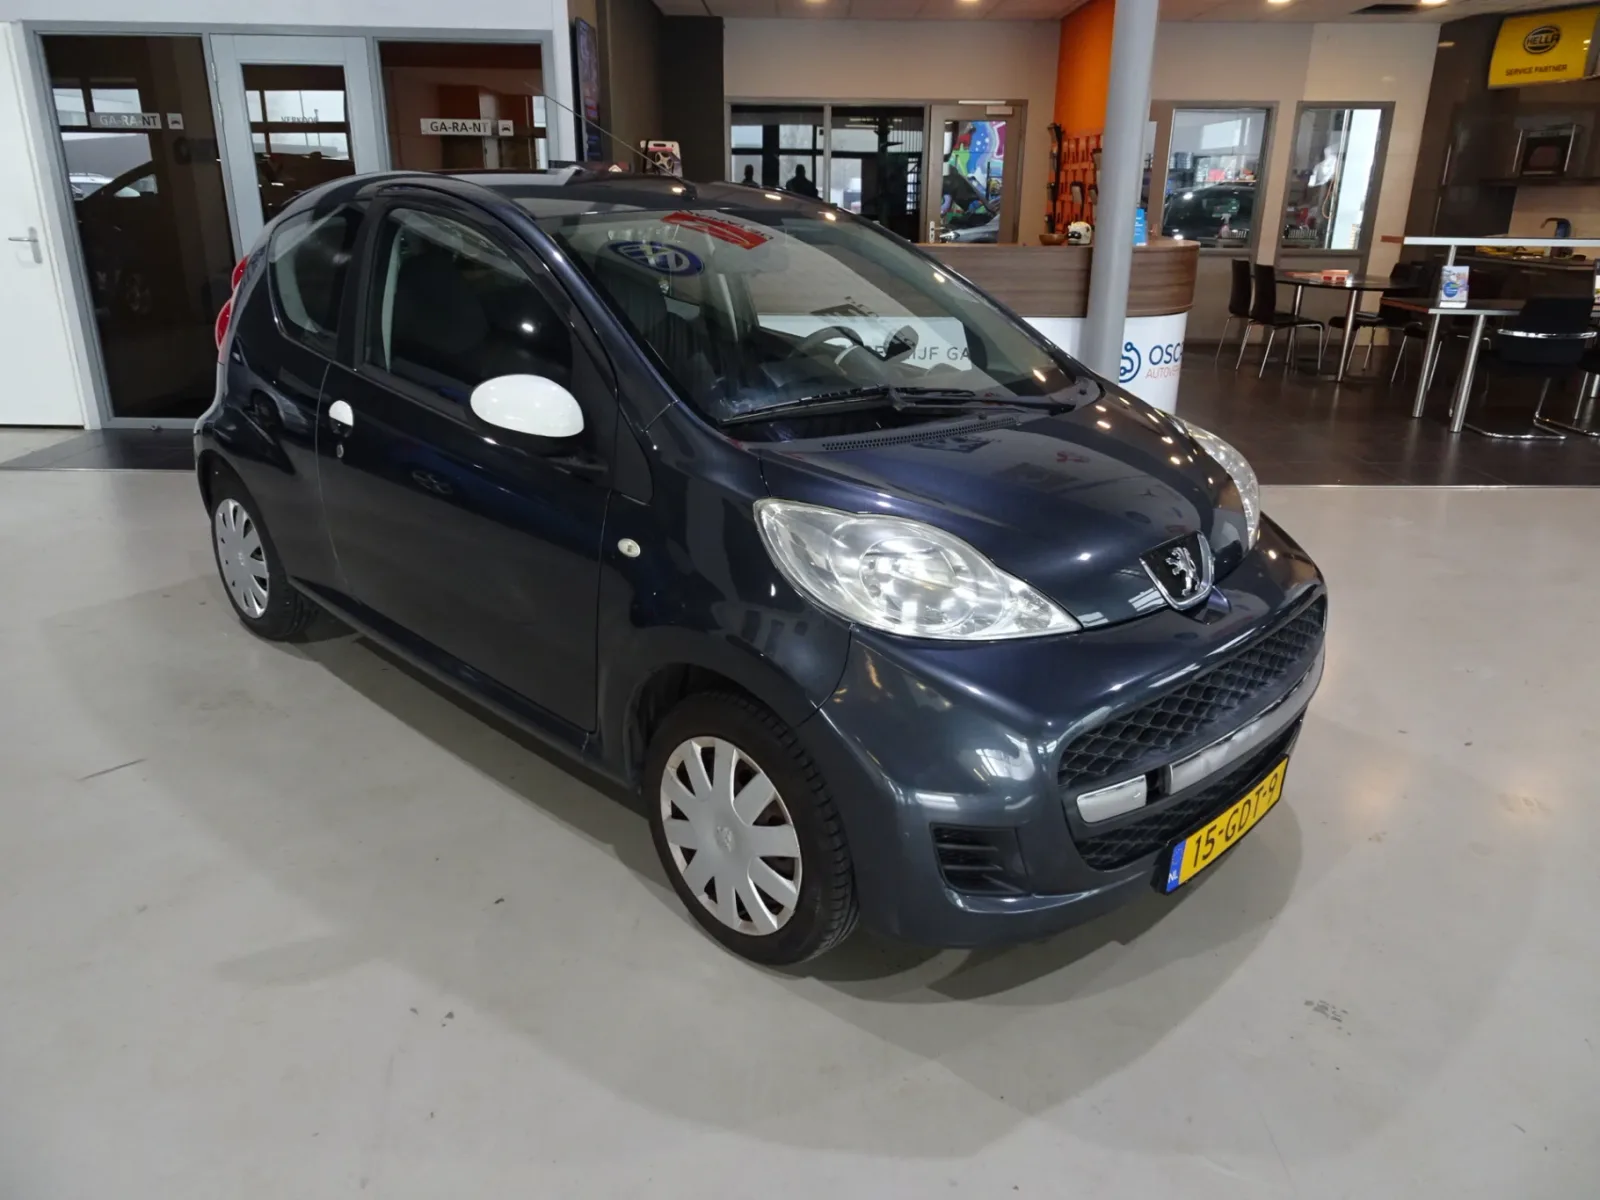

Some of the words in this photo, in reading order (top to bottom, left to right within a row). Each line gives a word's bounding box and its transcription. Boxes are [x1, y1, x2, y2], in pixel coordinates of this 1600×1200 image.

[1505, 67, 1533, 76] SERVICE
[1534, 64, 1568, 73] PARTNER
[100, 115, 157, 127] GA-RA-NT
[430, 121, 489, 133] GA-RA-NT
[1193, 772, 1279, 869] 15-GDT-9
[1167, 869, 1179, 884] NL
